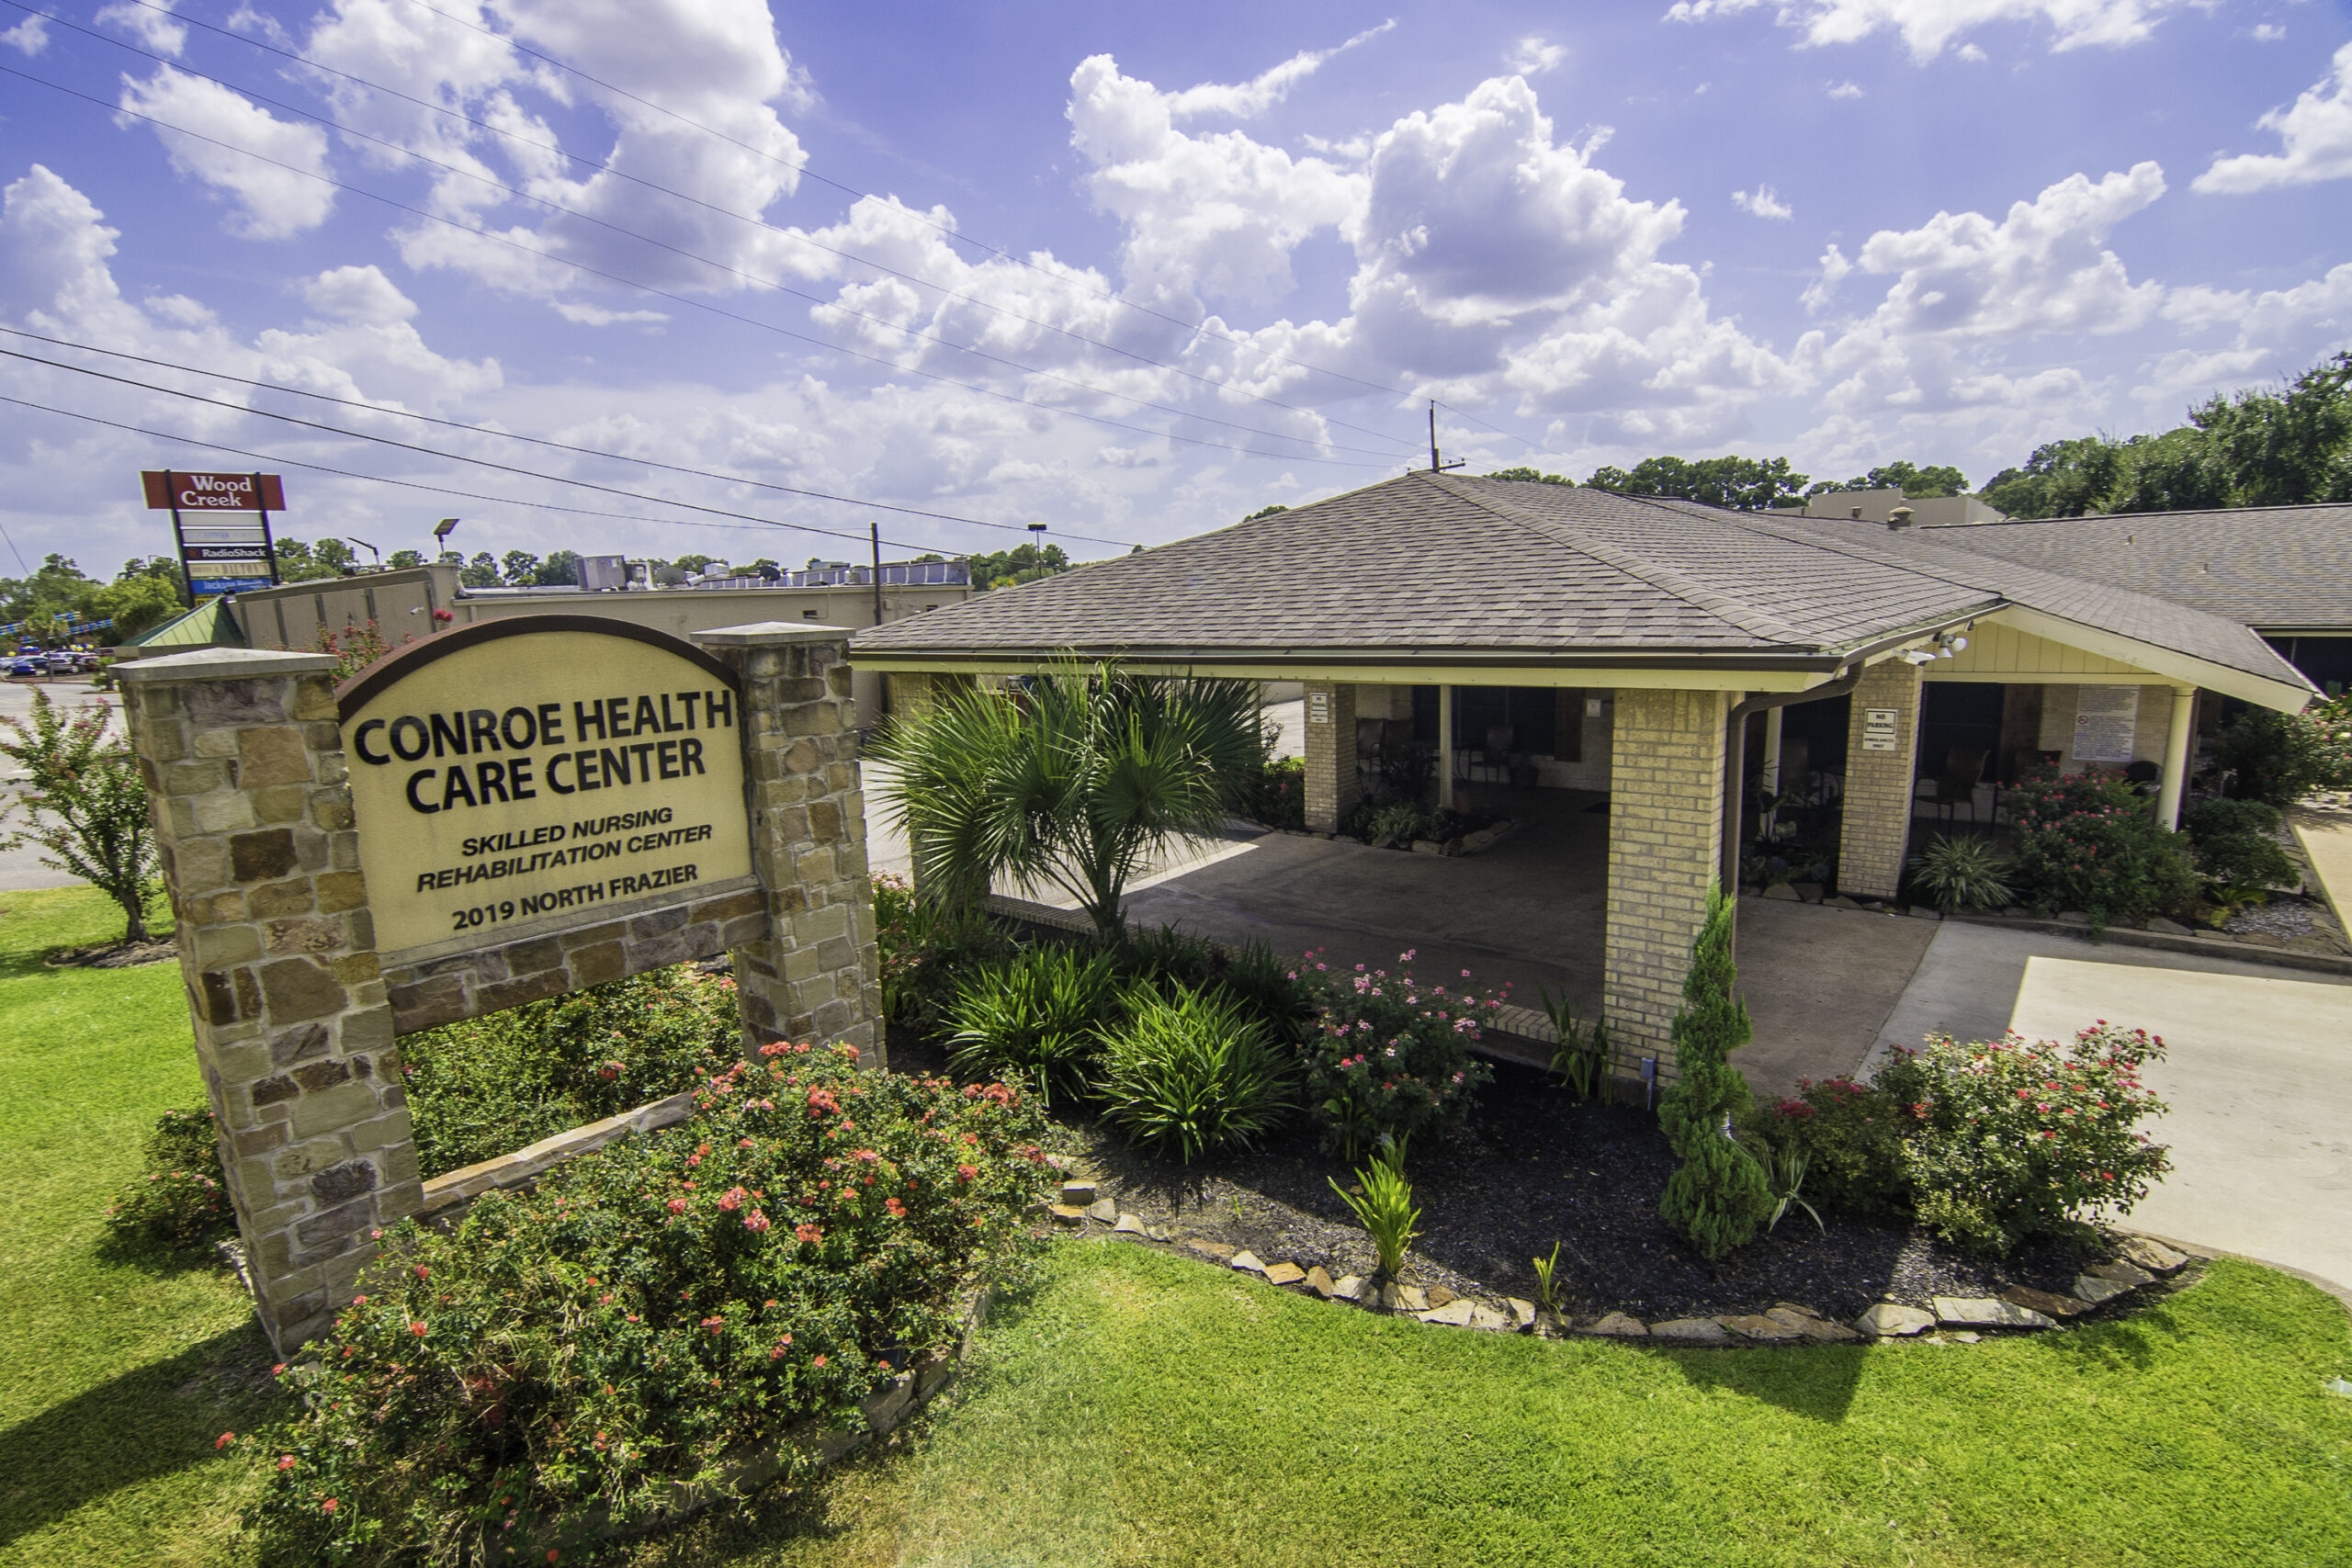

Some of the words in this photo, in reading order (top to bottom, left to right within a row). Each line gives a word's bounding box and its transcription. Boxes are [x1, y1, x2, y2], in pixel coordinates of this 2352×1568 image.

[180, 490, 243, 507] Creek
[190, 475, 253, 491] Wood
[202, 548, 266, 558] RadioShack
[354, 703, 565, 766] CONROE
[573, 690, 732, 741] HEALTH
[406, 757, 537, 815] CARE
[546, 738, 706, 795] CENTER
[416, 840, 621, 893] REHABILITATION
[627, 824, 713, 854] CENTER
[462, 825, 566, 857] SKILLED
[572, 807, 673, 840] NURSING
[452, 901, 514, 931] 2019
[521, 883, 605, 916] NORTH
[609, 863, 698, 897] FRAZIER
